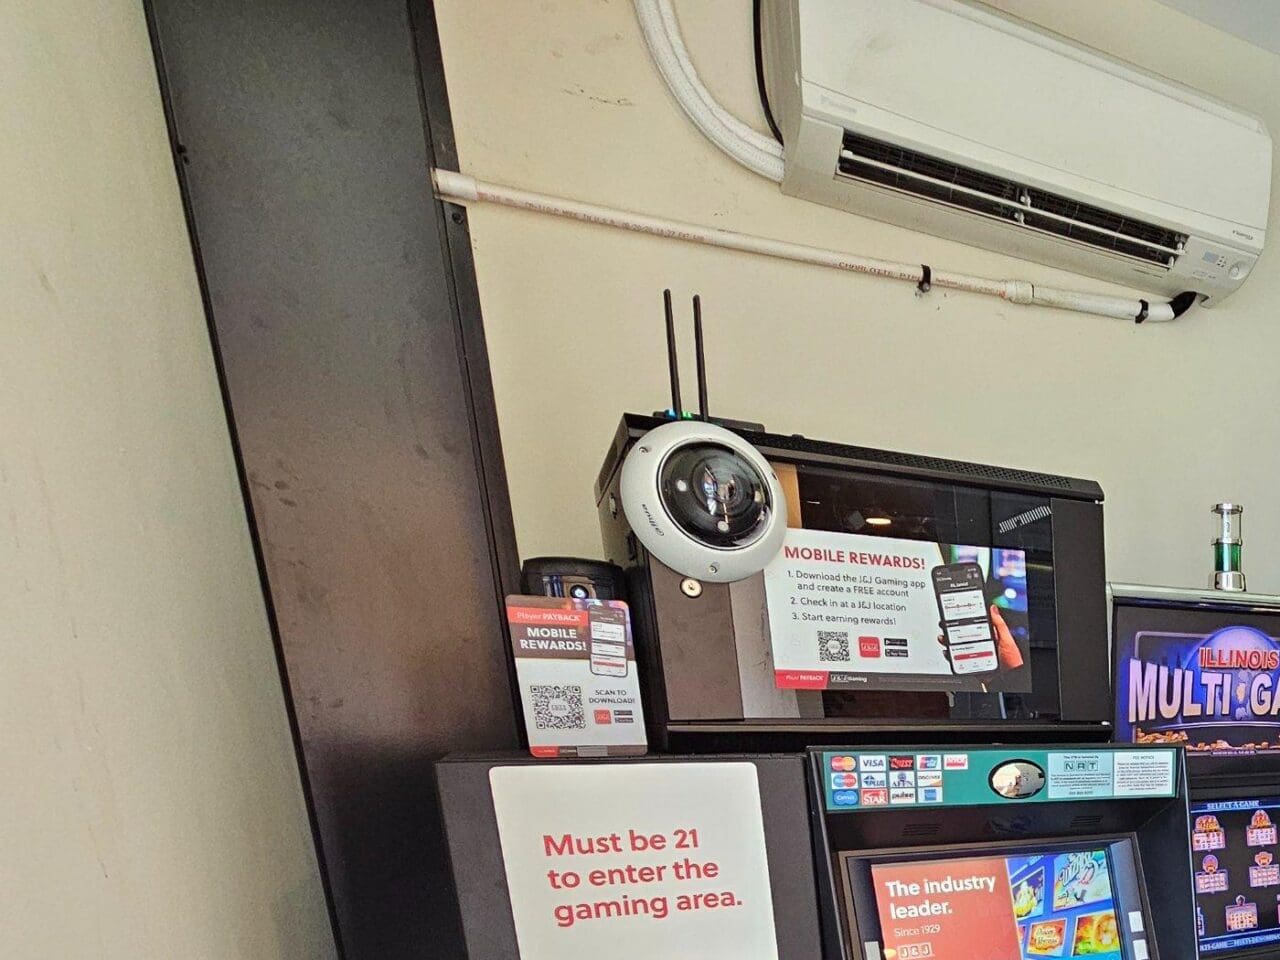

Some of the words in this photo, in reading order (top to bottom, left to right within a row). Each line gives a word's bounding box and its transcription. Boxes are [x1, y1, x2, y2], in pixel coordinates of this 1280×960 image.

[784, 546, 845, 564] MOBILE
[850, 554, 926, 570] REWARDS!
[787, 570, 794, 578] 1.
[796, 570, 841, 582] Download
[843, 575, 857, 583] the
[859, 575, 872, 584] J&J
[875, 577, 908, 588] Gaming
[910, 580, 926, 589] app
[797, 583, 815, 591] and
[817, 585, 844, 593] create
[853, 586, 874, 595] FREE
[876, 589, 909, 597] account
[800, 597, 828, 607] Check
[829, 599, 838, 607] in
[858, 601, 871, 609] J&J
[873, 601, 906, 611] location
[543, 612, 581, 621] PAYBACK
[792, 612, 799, 620] 3.
[802, 612, 823, 621] Start
[825, 614, 859, 625] earning
[861, 616, 896, 625] rewards!
[527, 627, 577, 638] MOBILE
[520, 640, 587, 650] REWARDS!
[1199, 647, 1280, 671] ILLINOIS
[1128, 658, 1232, 723] MULTI
[863, 794, 886, 805] STAR
[892, 791, 914, 799] pulse
[1207, 802, 1233, 810] SELECT
[1239, 800, 1259, 808] GAME
[543, 830, 622, 857] Must
[629, 829, 667, 851] be
[673, 828, 699, 849] 21
[547, 869, 581, 890] to
[588, 862, 666, 887] enter
[673, 858, 720, 880] the
[885, 880, 920, 897] The
[924, 875, 996, 895] industry
[553, 895, 668, 927] gaming
[676, 891, 742, 911] area.
[890, 901, 954, 920] leader.
[894, 926, 920, 938] Since
[921, 924, 941, 936] 1929
